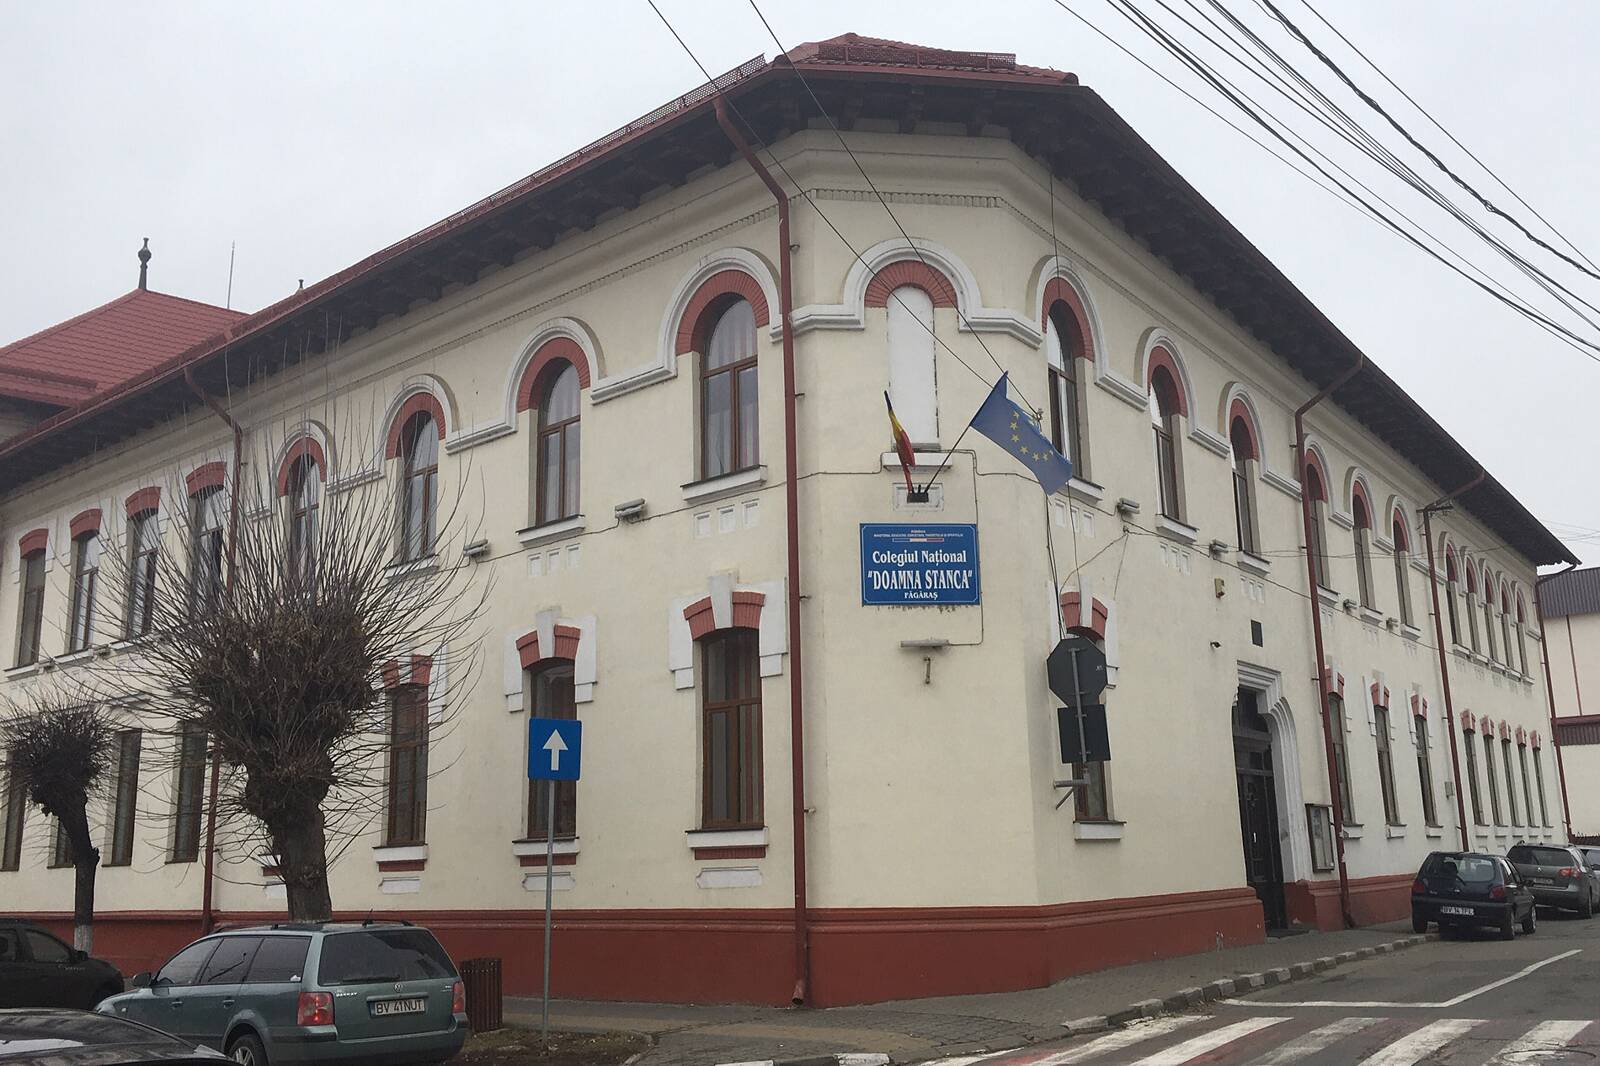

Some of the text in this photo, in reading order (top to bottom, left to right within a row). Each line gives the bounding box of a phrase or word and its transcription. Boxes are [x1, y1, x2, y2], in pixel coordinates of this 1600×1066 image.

[872, 549, 967, 567] Colegiul Național
[376, 1002, 390, 1014] BV
